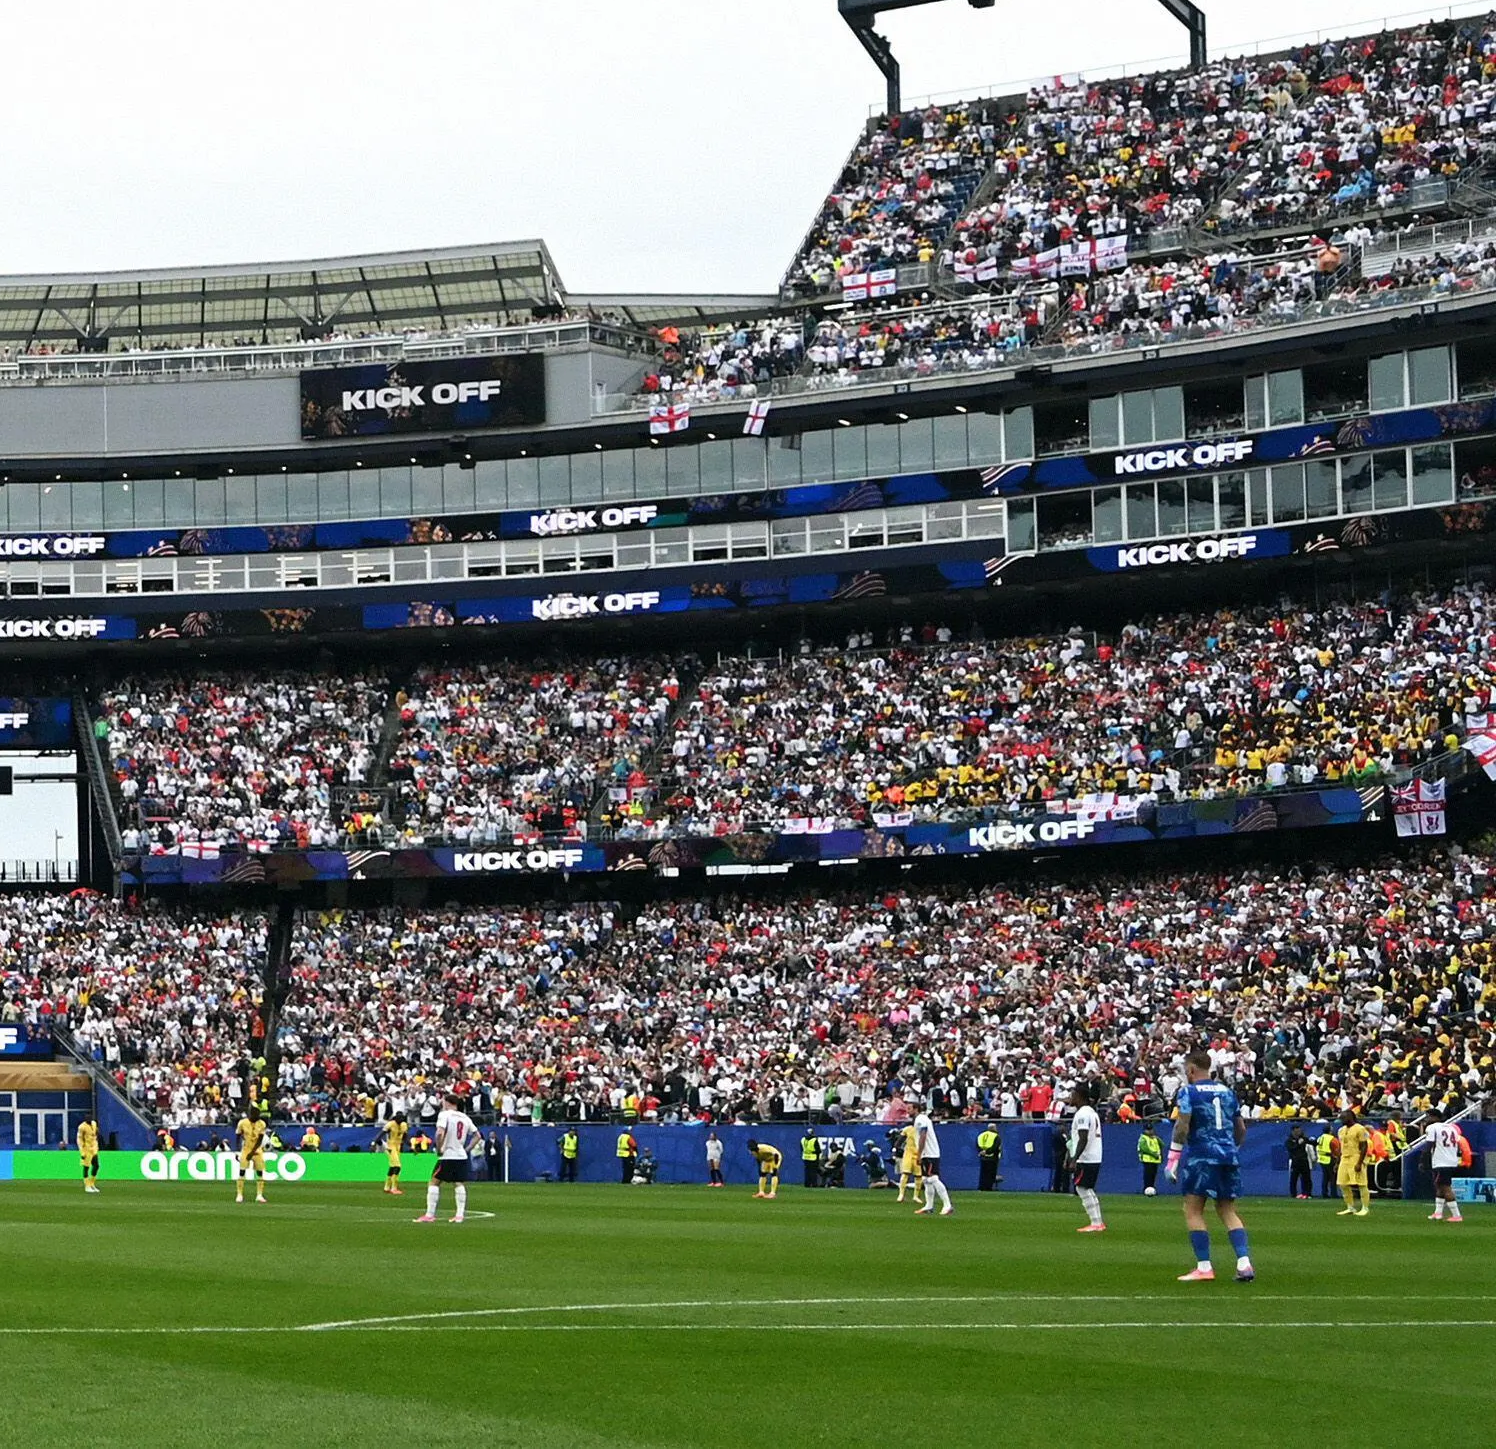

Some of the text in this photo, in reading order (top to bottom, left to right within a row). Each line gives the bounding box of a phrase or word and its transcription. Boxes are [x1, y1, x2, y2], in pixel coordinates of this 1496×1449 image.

[343, 380, 501, 410] KICK OFF
[1116, 441, 1253, 473] KICK OFF
[531, 506, 656, 536] KICK OFF
[53, 537, 105, 555] OFF
[1119, 536, 1257, 567] KICK OFF
[533, 591, 659, 620] KICK OFF
[54, 618, 106, 637] OFF
[970, 822, 1094, 847] KICK OFF
[454, 849, 583, 871] KICK OFF
[1213, 1097, 1222, 1130] 1
[457, 1121, 464, 1140] 8
[1441, 1130, 1457, 1148] 24
